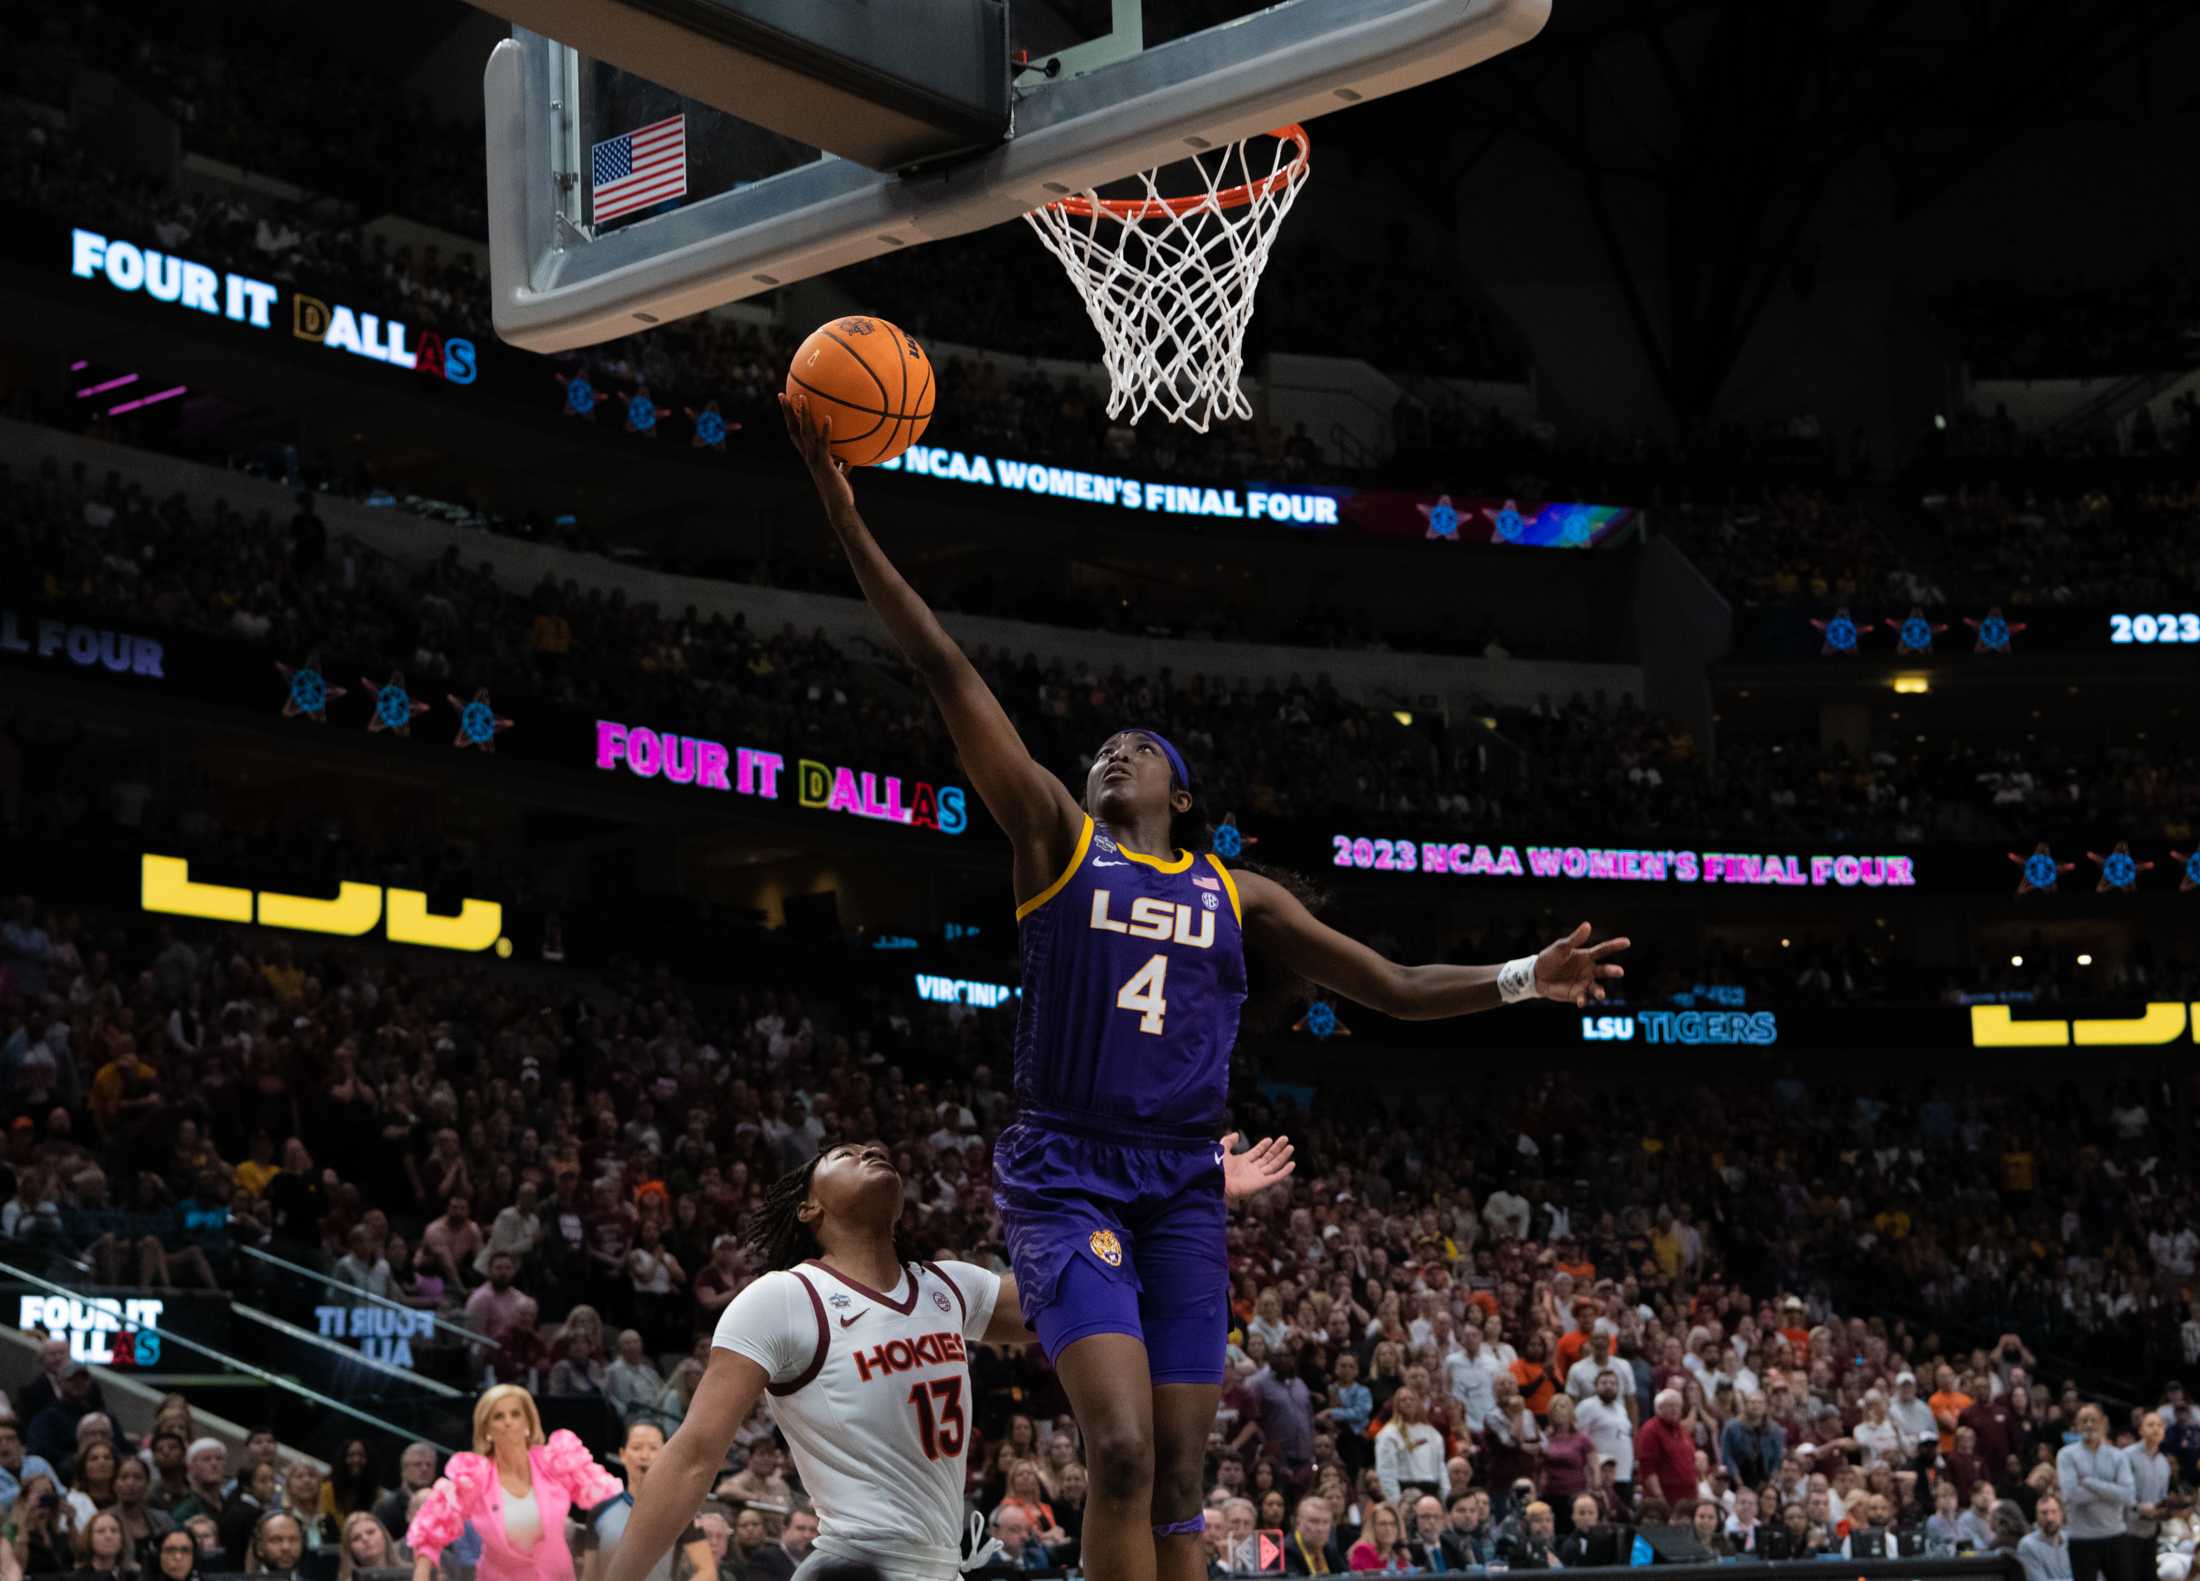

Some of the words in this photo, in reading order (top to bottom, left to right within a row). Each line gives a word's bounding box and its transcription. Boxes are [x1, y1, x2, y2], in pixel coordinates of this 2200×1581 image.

[72, 228, 220, 315] FOUR
[225, 272, 278, 329] IT
[293, 293, 478, 385] DALLAS
[905, 445, 995, 485] NCAA
[996, 459, 1142, 509] WOMEN'S
[1145, 483, 1244, 517] FINAL
[1247, 492, 1339, 525] FOUR
[39, 618, 165, 680] FOUR
[2110, 613, 2200, 643] 2023
[596, 720, 732, 791] FOUR
[736, 747, 784, 799] IT
[798, 758, 967, 835] DALLAS
[1332, 835, 1417, 871] 2023
[1422, 842, 1524, 876] NCAA
[1526, 846, 1699, 881] WOMEN'S
[1702, 853, 1808, 885] FINAL
[1811, 855, 1915, 886] FOUR
[1090, 888, 1215, 949] LSU
[1116, 953, 1169, 1036] 4
[1582, 1016, 1634, 1040] LSU
[1637, 1010, 1778, 1045] TIGERS
[19, 1295, 121, 1331] FOUR
[125, 1298, 163, 1332] IT
[907, 1375, 965, 1462] 13
